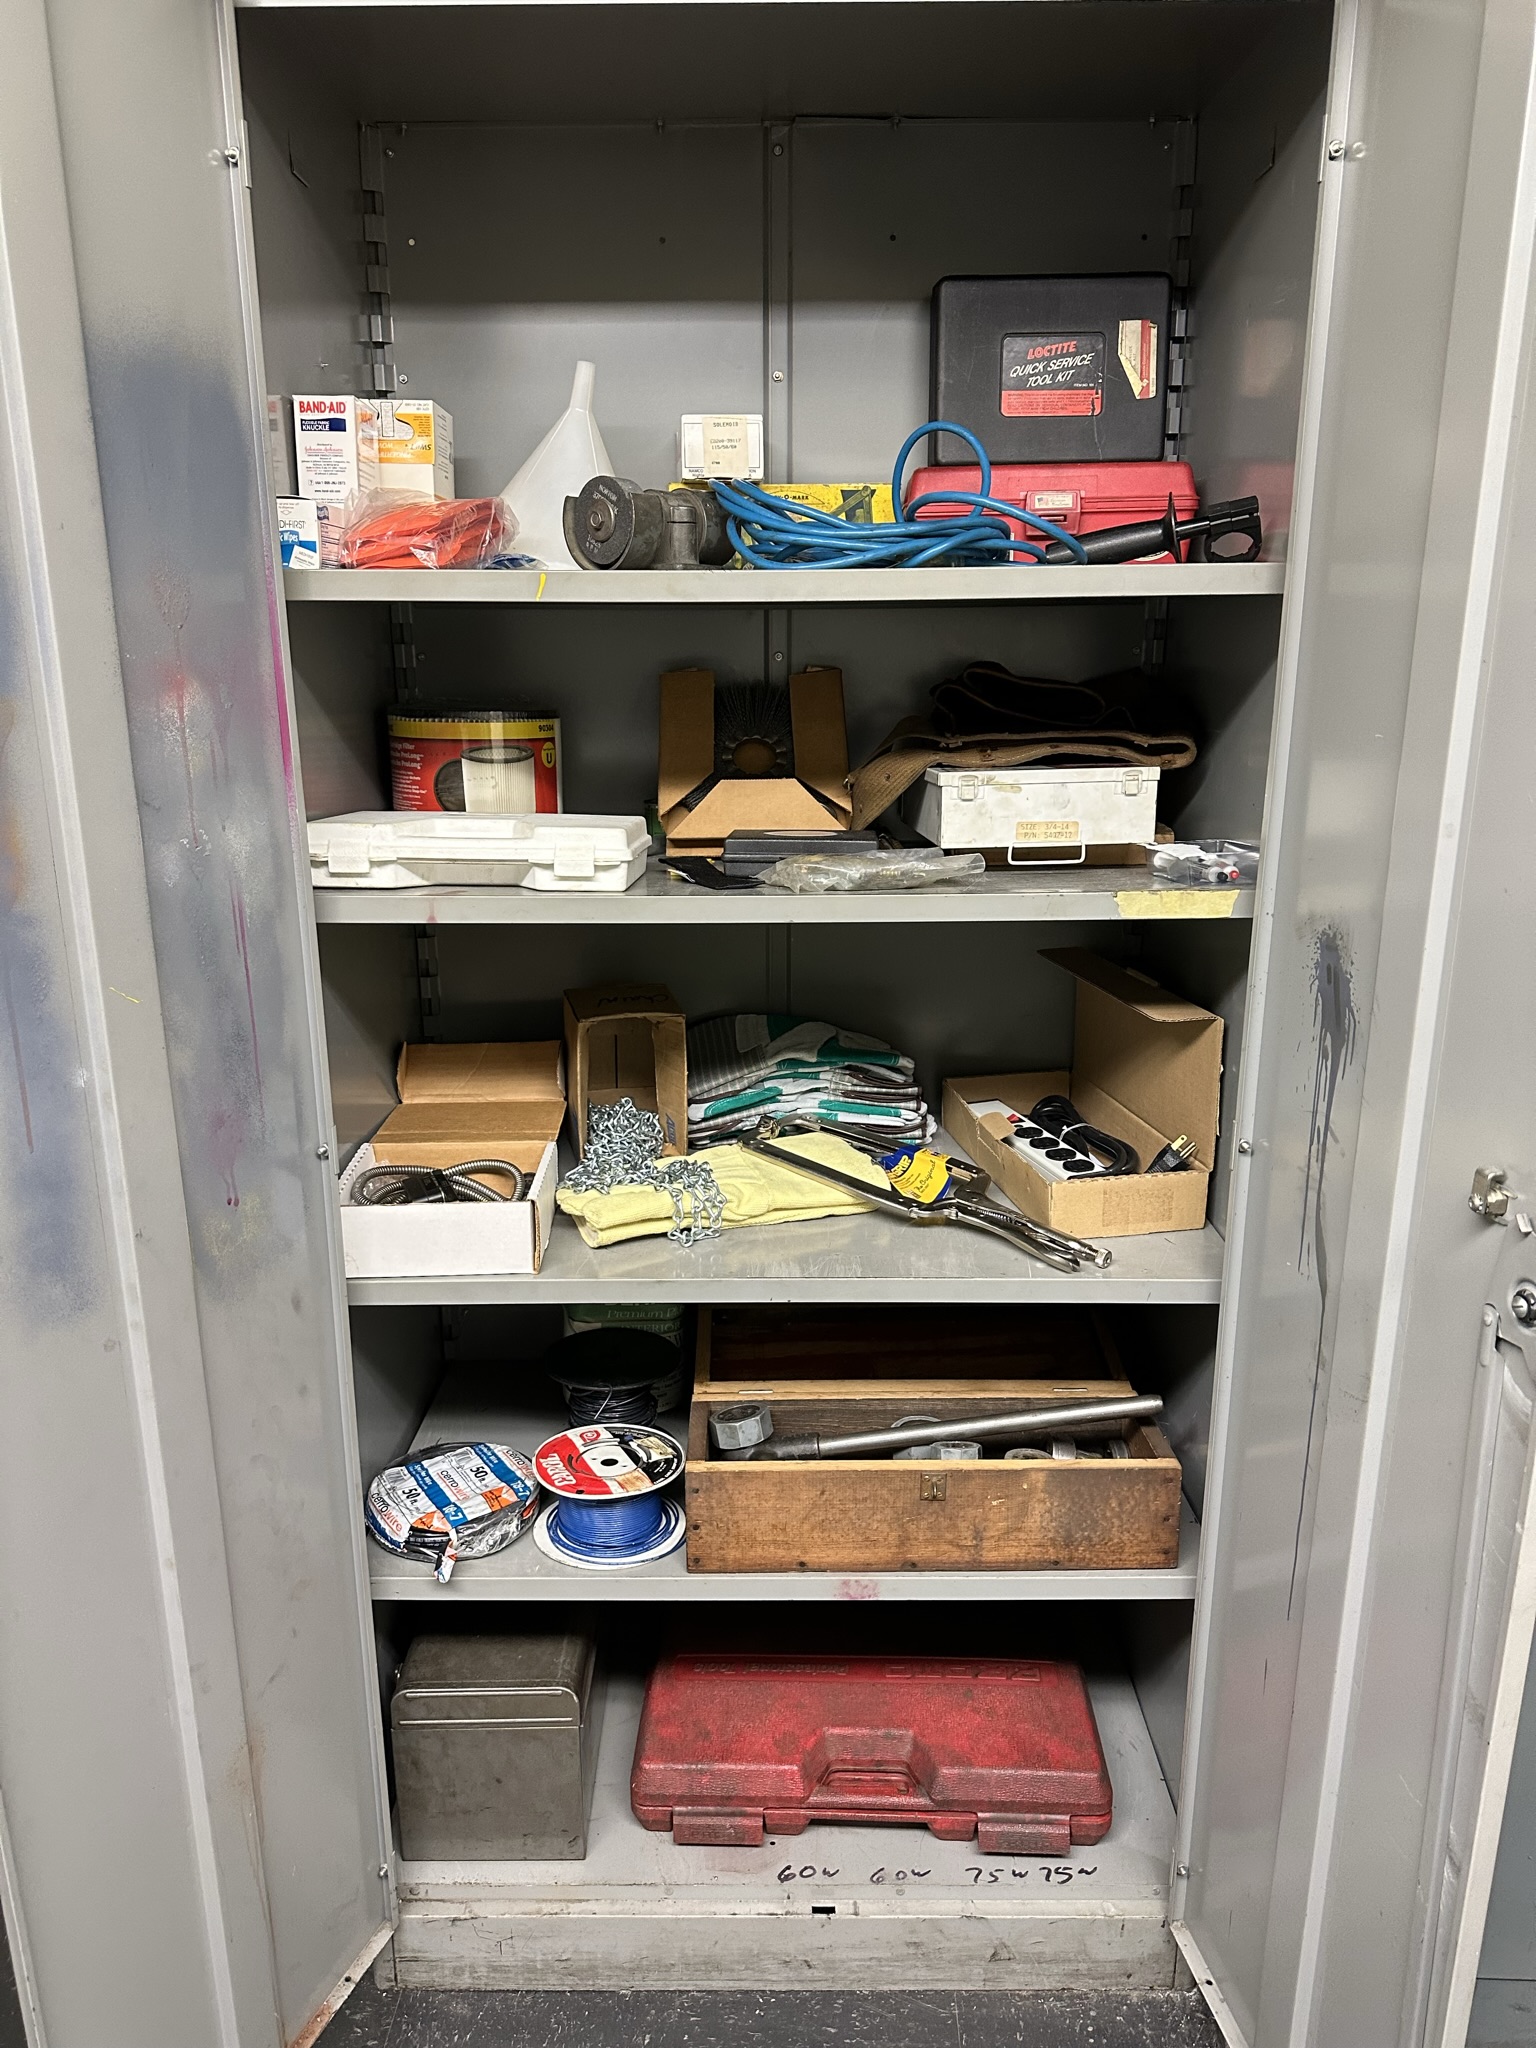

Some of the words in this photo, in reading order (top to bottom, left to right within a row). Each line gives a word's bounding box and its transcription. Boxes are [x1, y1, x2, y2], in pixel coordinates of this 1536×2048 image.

[1027, 340, 1077, 360] LOCTITE
[1009, 361, 1048, 378] QUICK
[1047, 352, 1095, 371] SERVICE
[1026, 373, 1053, 388] TOOL
[1055, 369, 1075, 383] KIT
[299, 401, 346, 414] BAND-AID
[280, 520, 305, 529] DI-FIRST
[546, 752, 553, 764] U
[1020, 823, 1040, 831] SIZE:
[607, 1309, 663, 1319] Premium
[621, 1322, 681, 1332] TERIOR
[539, 1452, 577, 1487] CAROL
[440, 1470, 470, 1501] cerrowire
[371, 1492, 403, 1533] cerrowire
